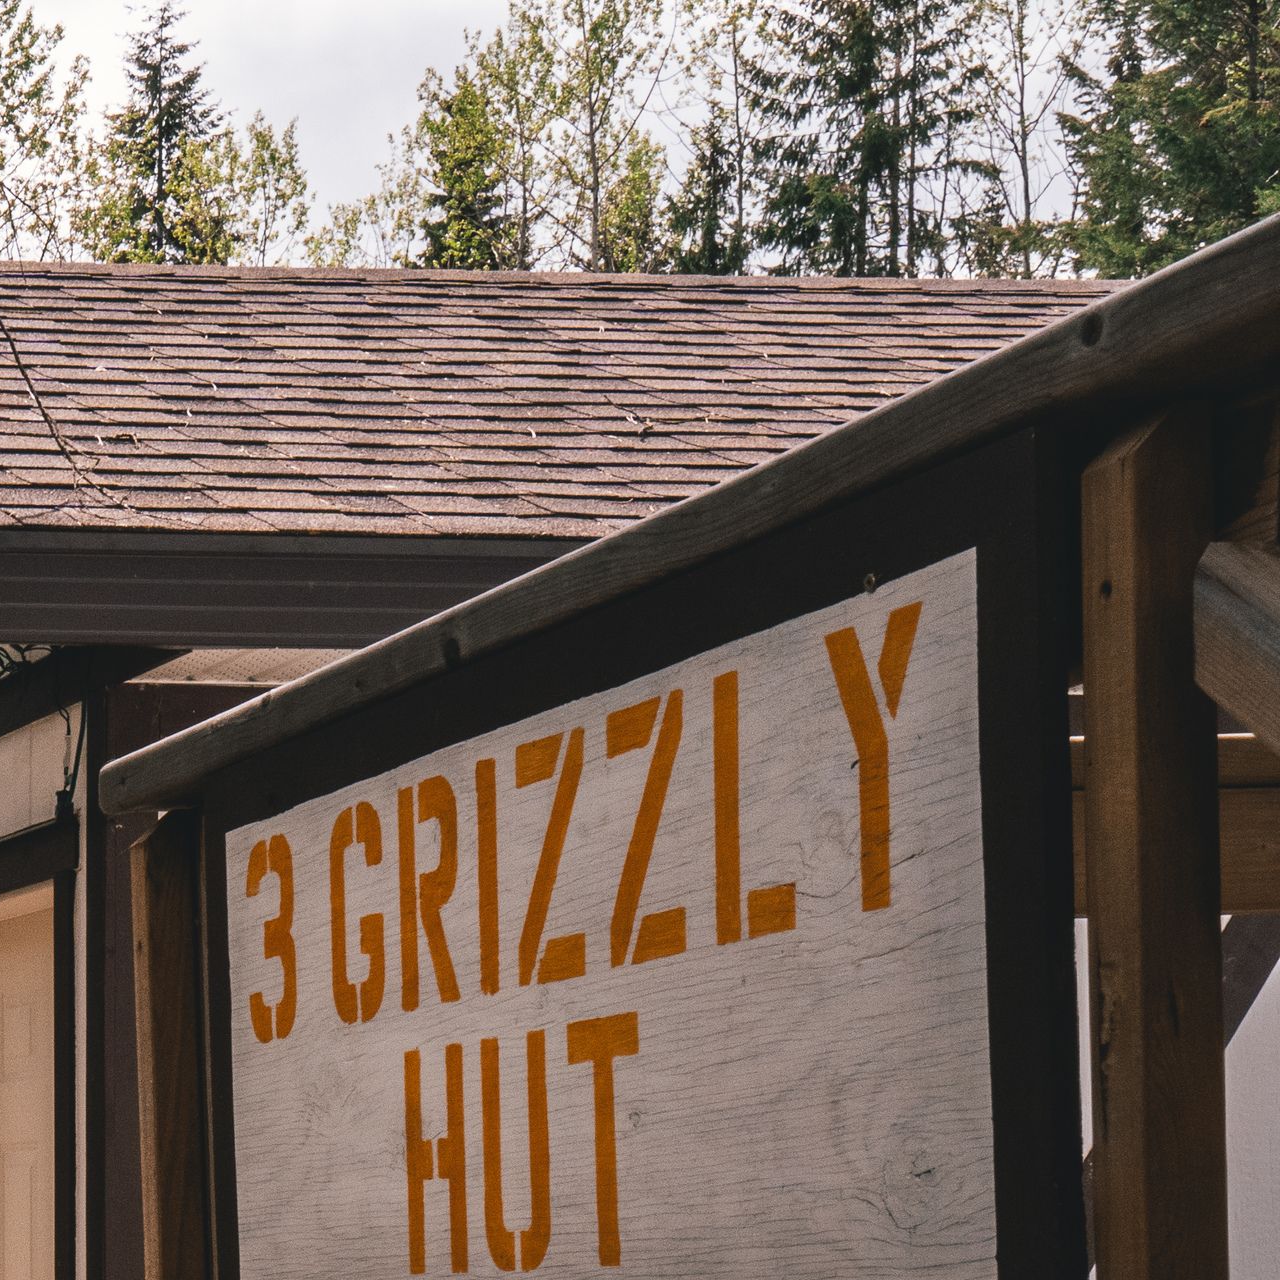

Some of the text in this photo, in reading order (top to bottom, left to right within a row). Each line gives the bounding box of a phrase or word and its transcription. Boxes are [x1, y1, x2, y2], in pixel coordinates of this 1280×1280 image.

[244, 601, 923, 1044] 3 GRIZZLY
[404, 1011, 639, 1276] HUT
